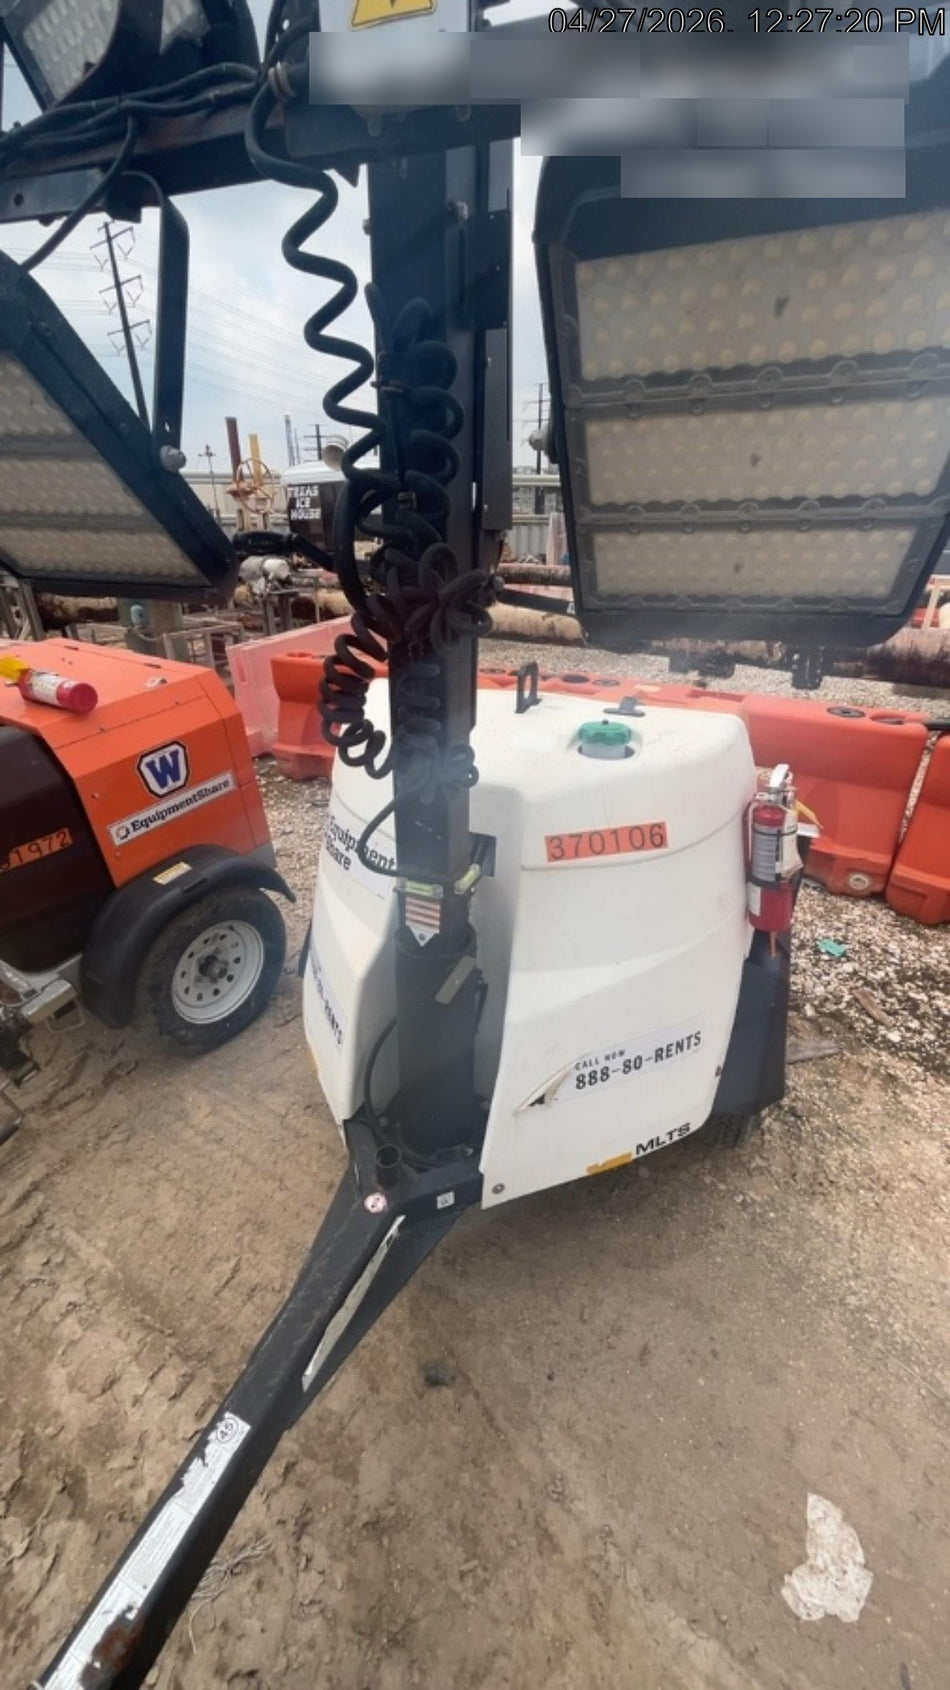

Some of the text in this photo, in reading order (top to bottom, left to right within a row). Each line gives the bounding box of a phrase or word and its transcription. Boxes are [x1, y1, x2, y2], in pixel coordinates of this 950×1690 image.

[145, 749, 182, 790] W
[130, 779, 230, 832] EquipmentShare
[549, 823, 665, 860] 370106
[574, 1049, 626, 1071] CALL NOW
[575, 1030, 702, 1090] 888-80-RENTS
[635, 1122, 691, 1156] MLTS
